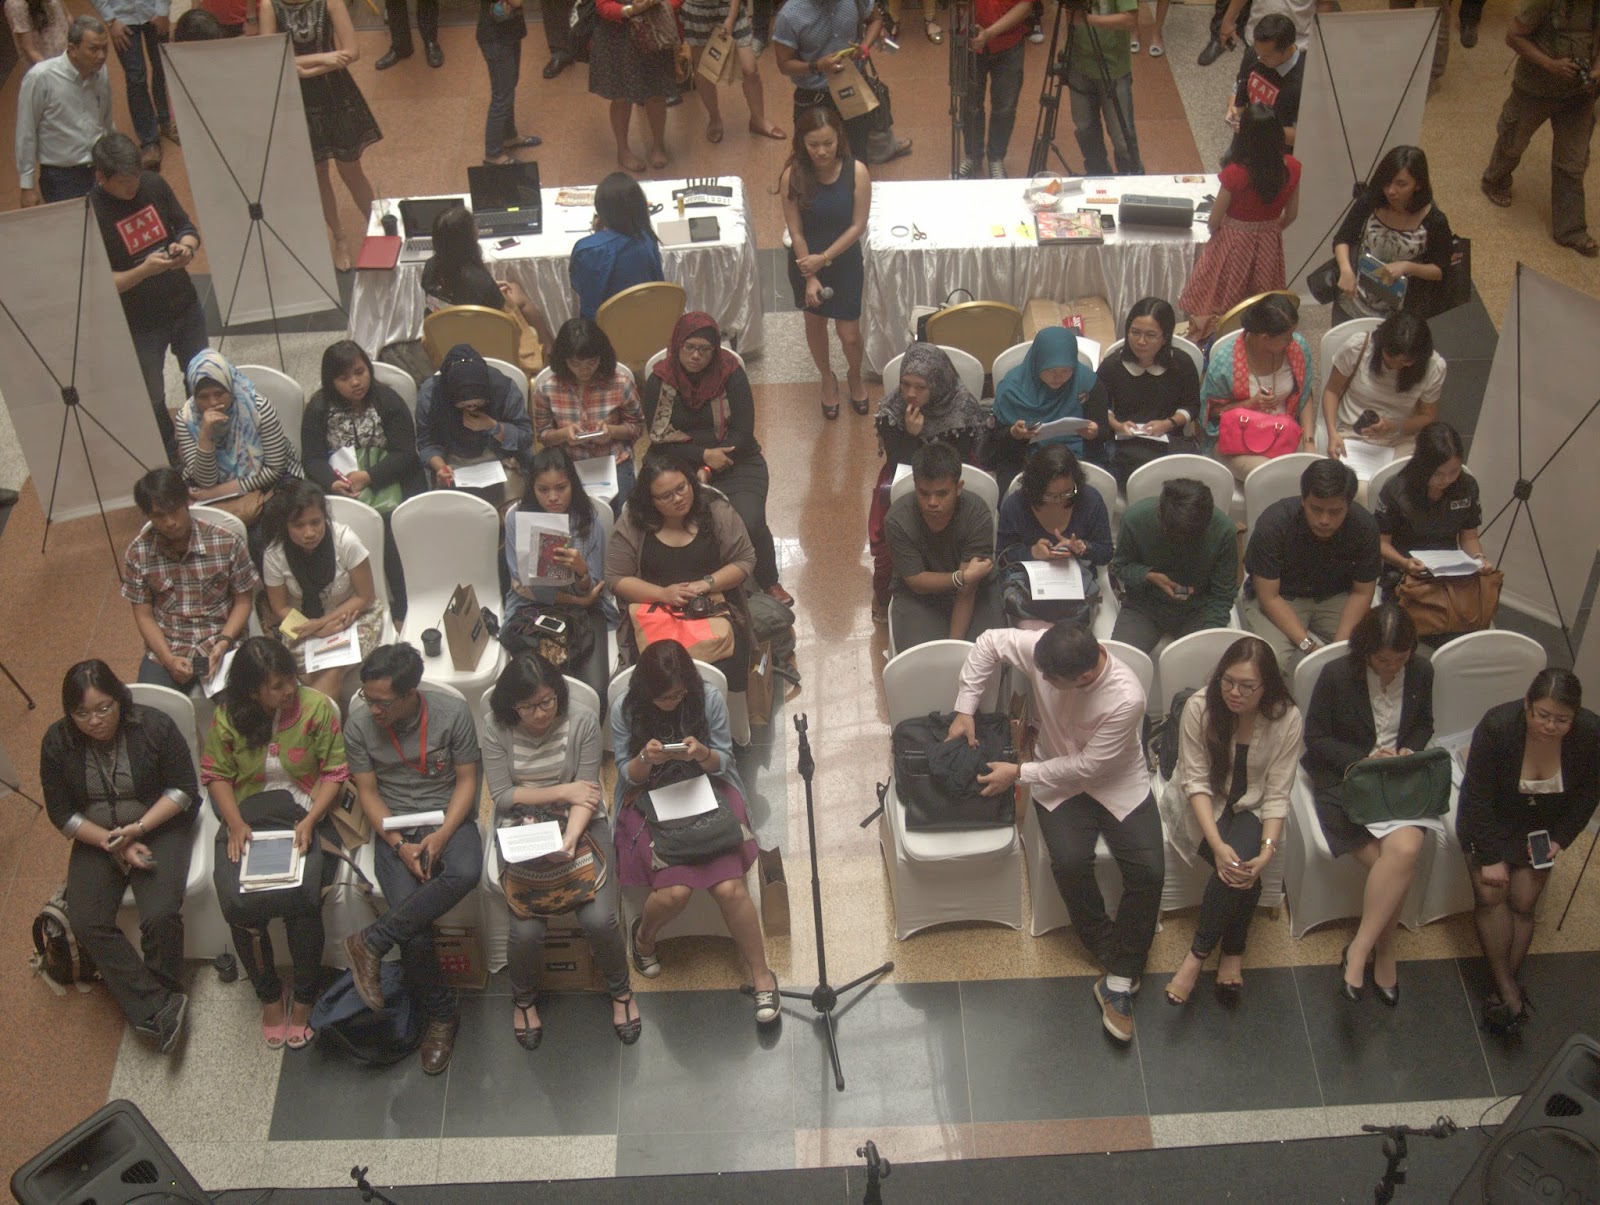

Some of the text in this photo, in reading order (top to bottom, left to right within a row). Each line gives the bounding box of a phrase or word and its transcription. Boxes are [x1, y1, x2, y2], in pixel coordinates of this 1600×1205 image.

[1252, 78, 1273, 99] EAT
[125, 211, 153, 234] EAT
[133, 225, 161, 248] JKT
